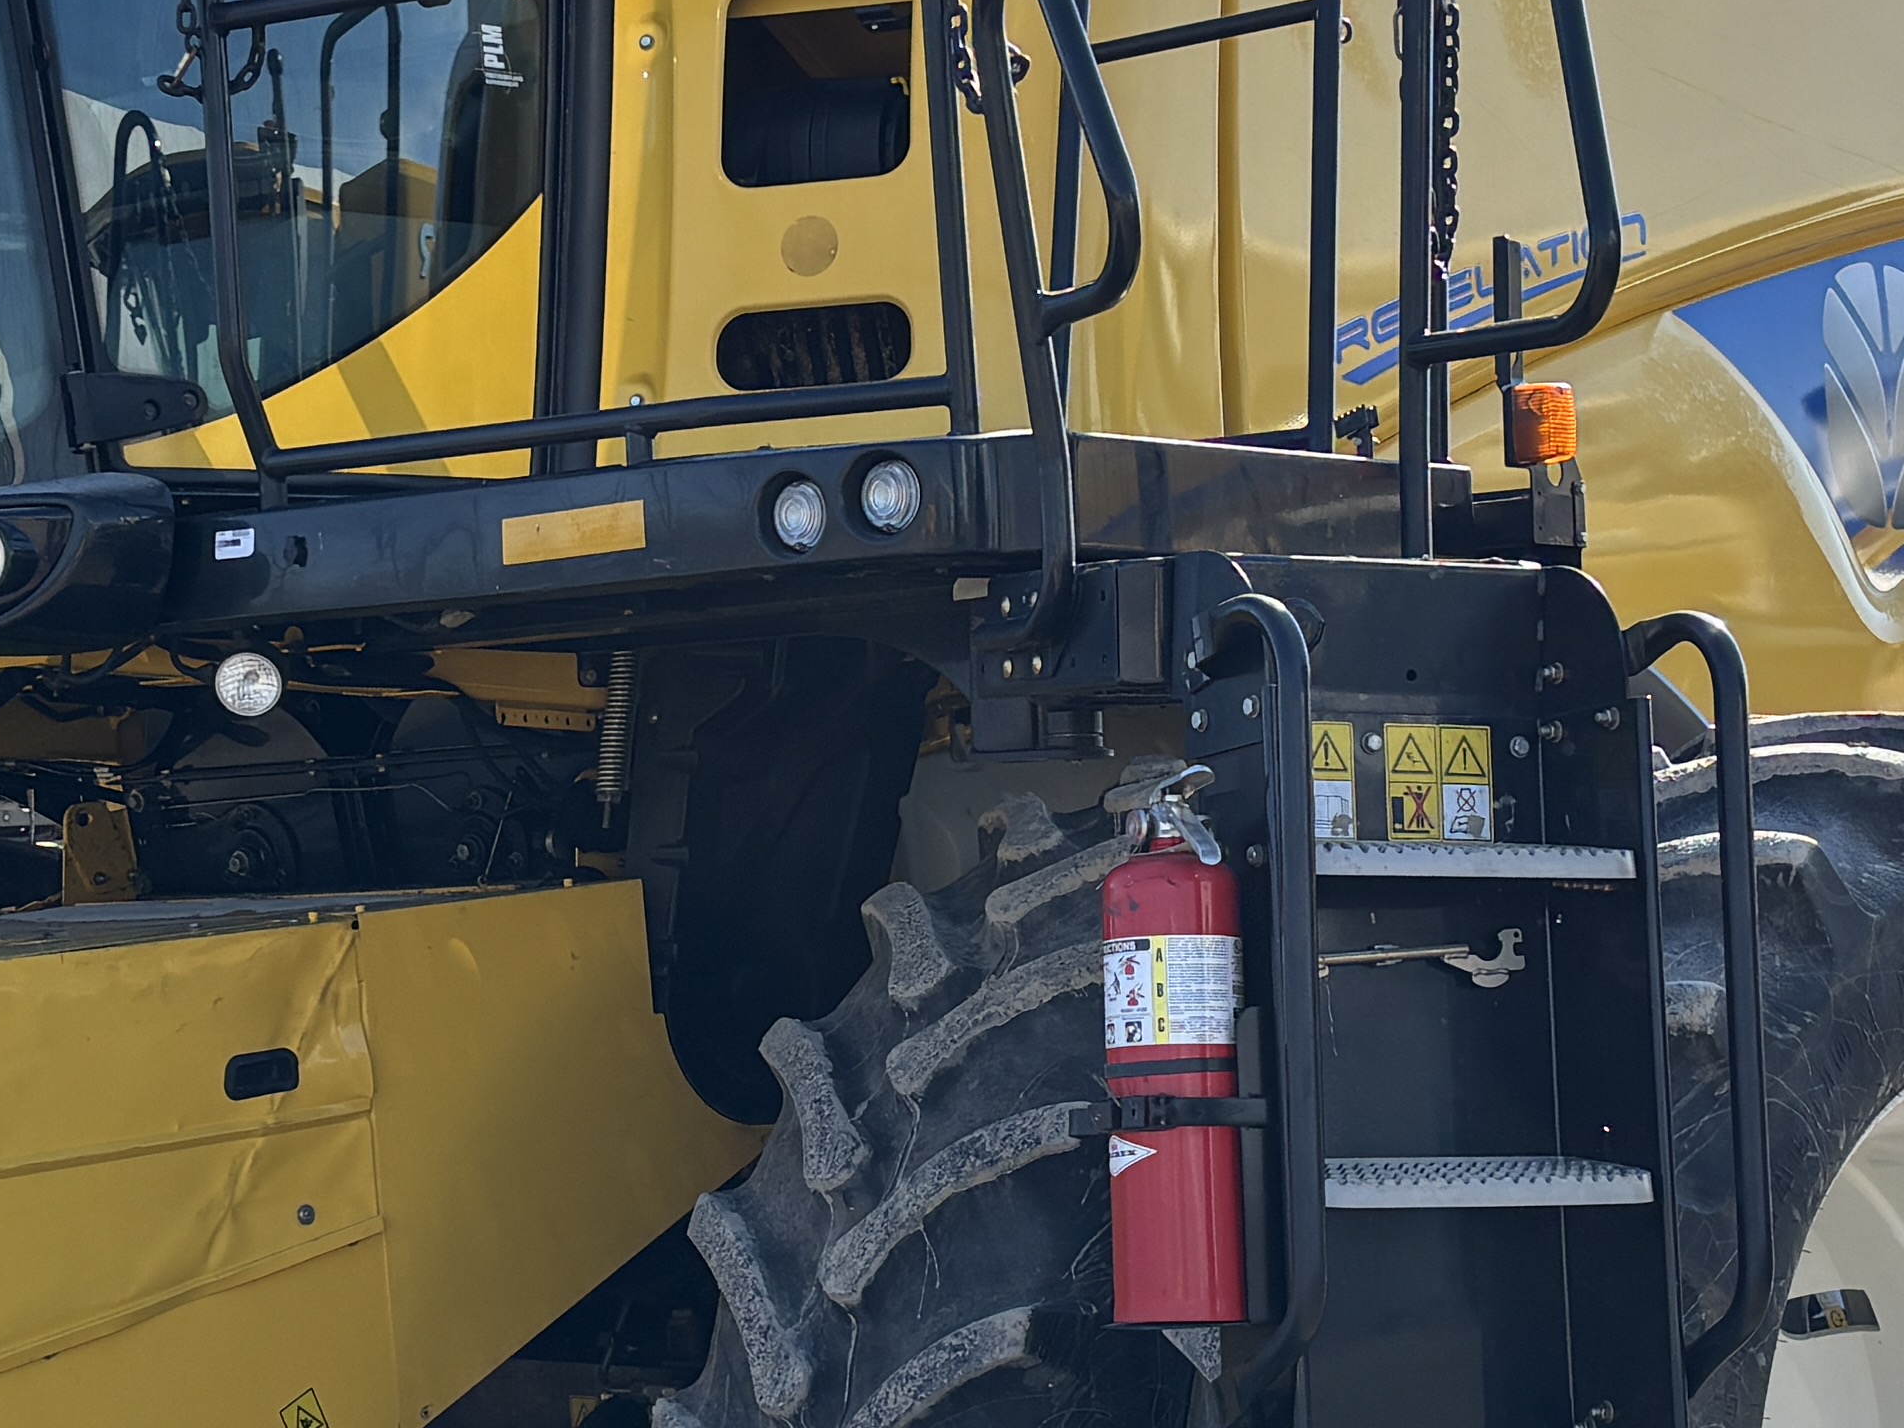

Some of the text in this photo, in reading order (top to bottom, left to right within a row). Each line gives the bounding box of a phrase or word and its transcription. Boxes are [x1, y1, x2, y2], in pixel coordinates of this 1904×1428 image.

[481, 24, 505, 69] PLM
[1156, 948, 1163, 962] A
[1156, 983, 1164, 997] B
[1158, 1017, 1165, 1032] C
